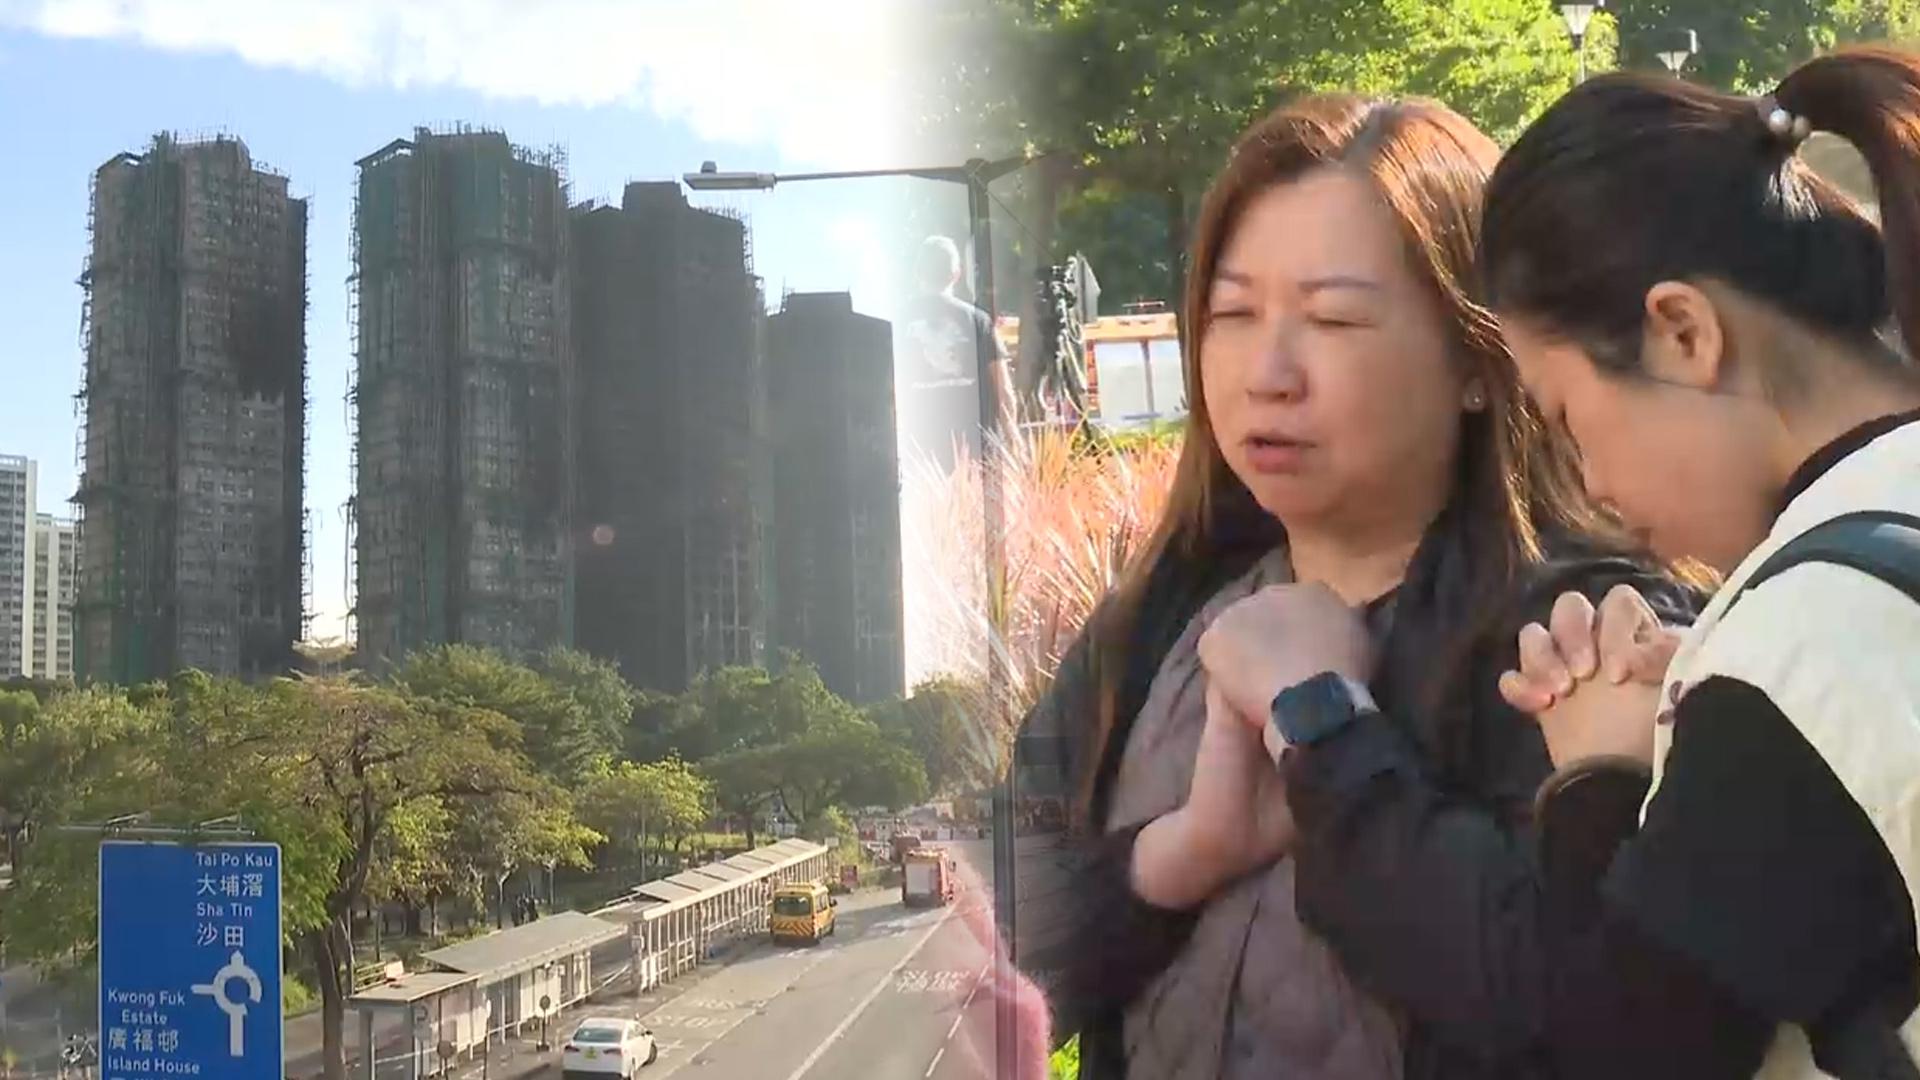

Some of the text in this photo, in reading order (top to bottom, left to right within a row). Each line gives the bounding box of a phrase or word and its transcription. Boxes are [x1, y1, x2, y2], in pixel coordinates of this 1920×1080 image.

[196, 852, 273, 868] Tai Po Kau
[197, 872, 263, 897] 大埔滘
[196, 902, 253, 917] Sha Tin
[197, 922, 244, 947] 沙田
[107, 986, 186, 1008] Kwong Fuk
[121, 1008, 168, 1025] Estate
[107, 1055, 200, 1074] Island House
